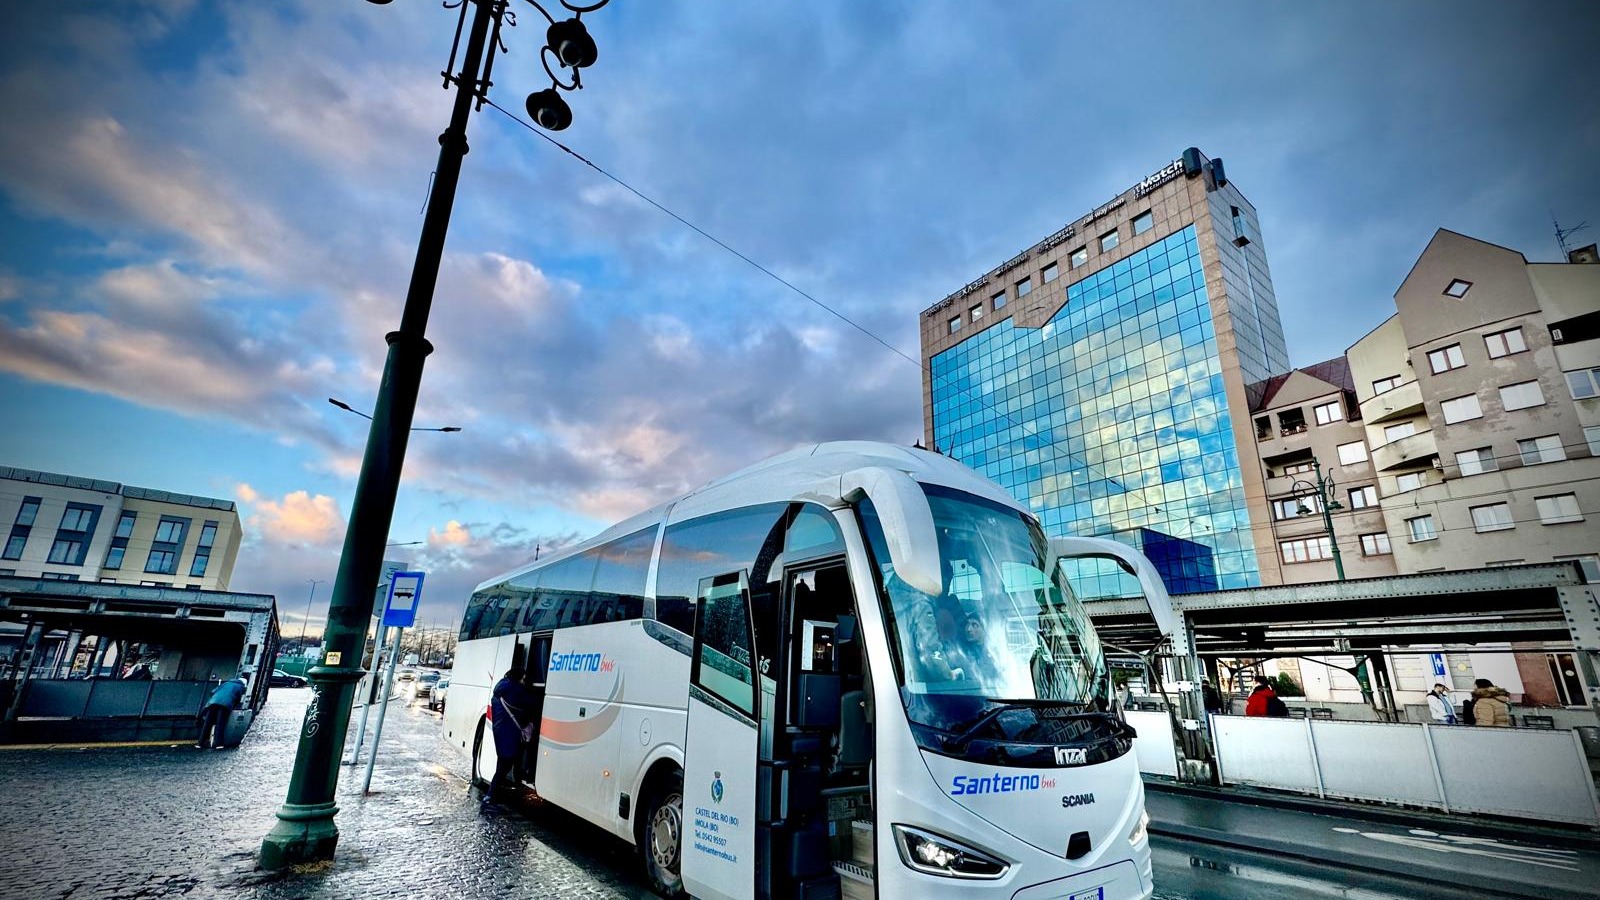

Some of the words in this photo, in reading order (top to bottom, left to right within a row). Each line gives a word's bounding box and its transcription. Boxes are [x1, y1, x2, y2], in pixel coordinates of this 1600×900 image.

[549, 650, 602, 672] Santerno
[600, 653, 615, 673] bus
[951, 773, 1040, 795] Santerno
[1041, 774, 1056, 789] bus
[1062, 793, 1096, 808] SCANIA
[695, 807, 711, 818] CASTEL
[711, 811, 720, 821] DEL
[720, 813, 729, 823] RIO
[695, 819, 709, 829] IMOLA
